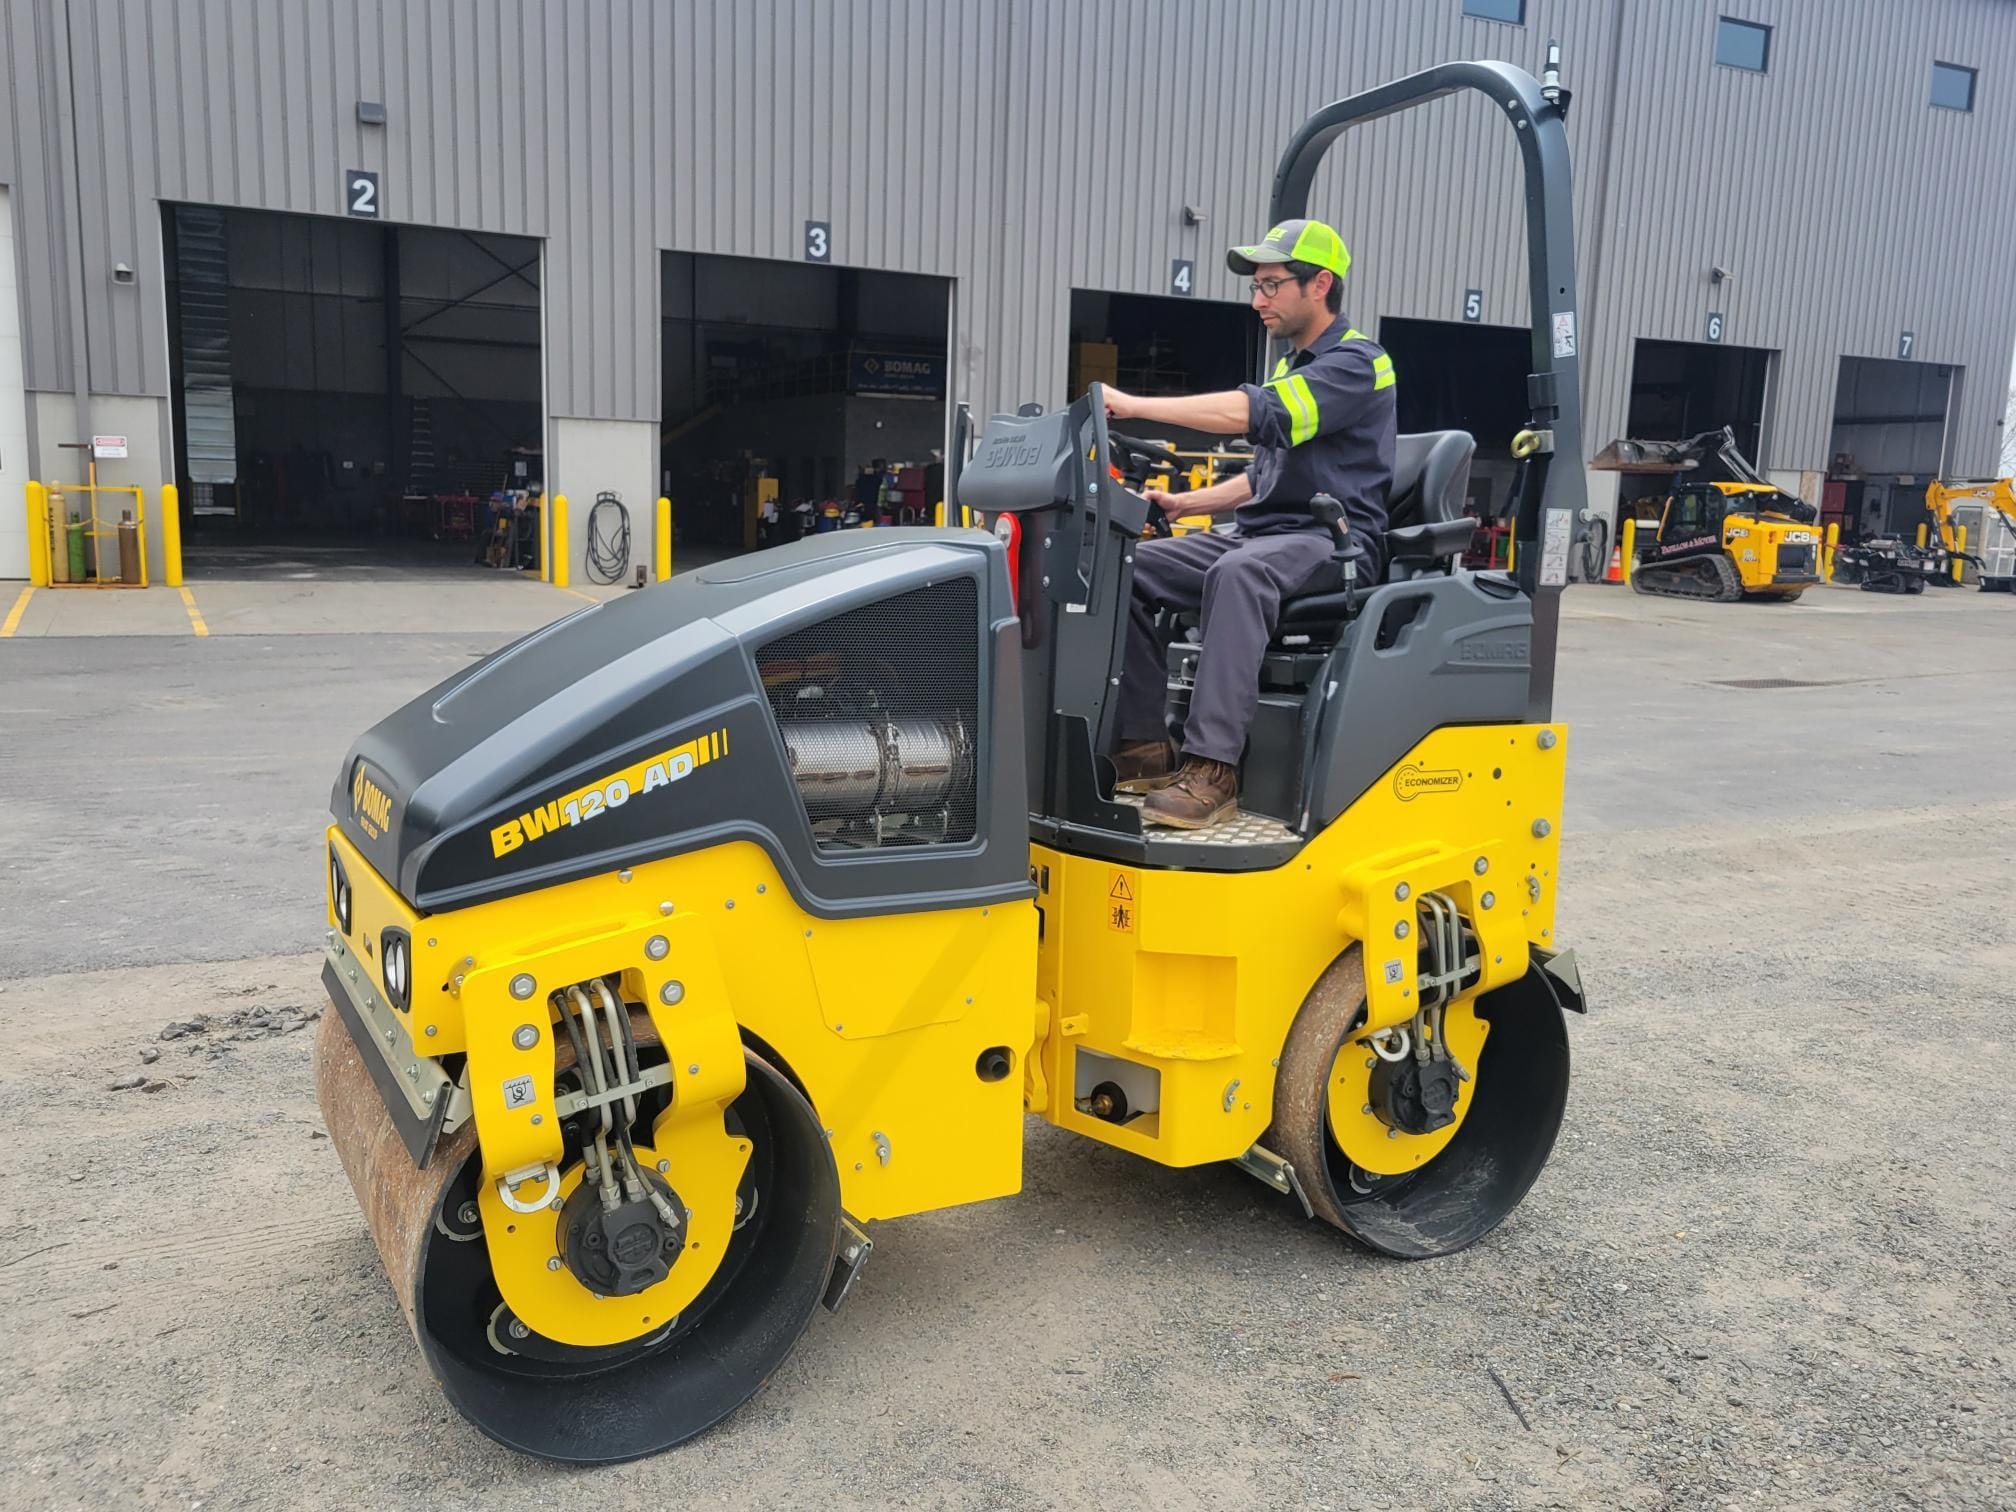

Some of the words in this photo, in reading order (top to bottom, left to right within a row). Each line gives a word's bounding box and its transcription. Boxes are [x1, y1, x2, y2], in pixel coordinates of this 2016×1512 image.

[352, 179, 375, 213] 2
[809, 227, 827, 257] 3
[1174, 266, 1190, 292] 4
[1466, 294, 1480, 318] 5
[1709, 317, 1720, 339] 6
[1902, 336, 1912, 356] 7
[883, 360, 931, 375] BOMAG
[1726, 527, 1749, 537] JCB
[1784, 530, 1811, 543] JCB
[642, 752, 694, 795] AD
[1405, 776, 1459, 787] ECONOMIZER
[362, 779, 392, 833] BOMAG
